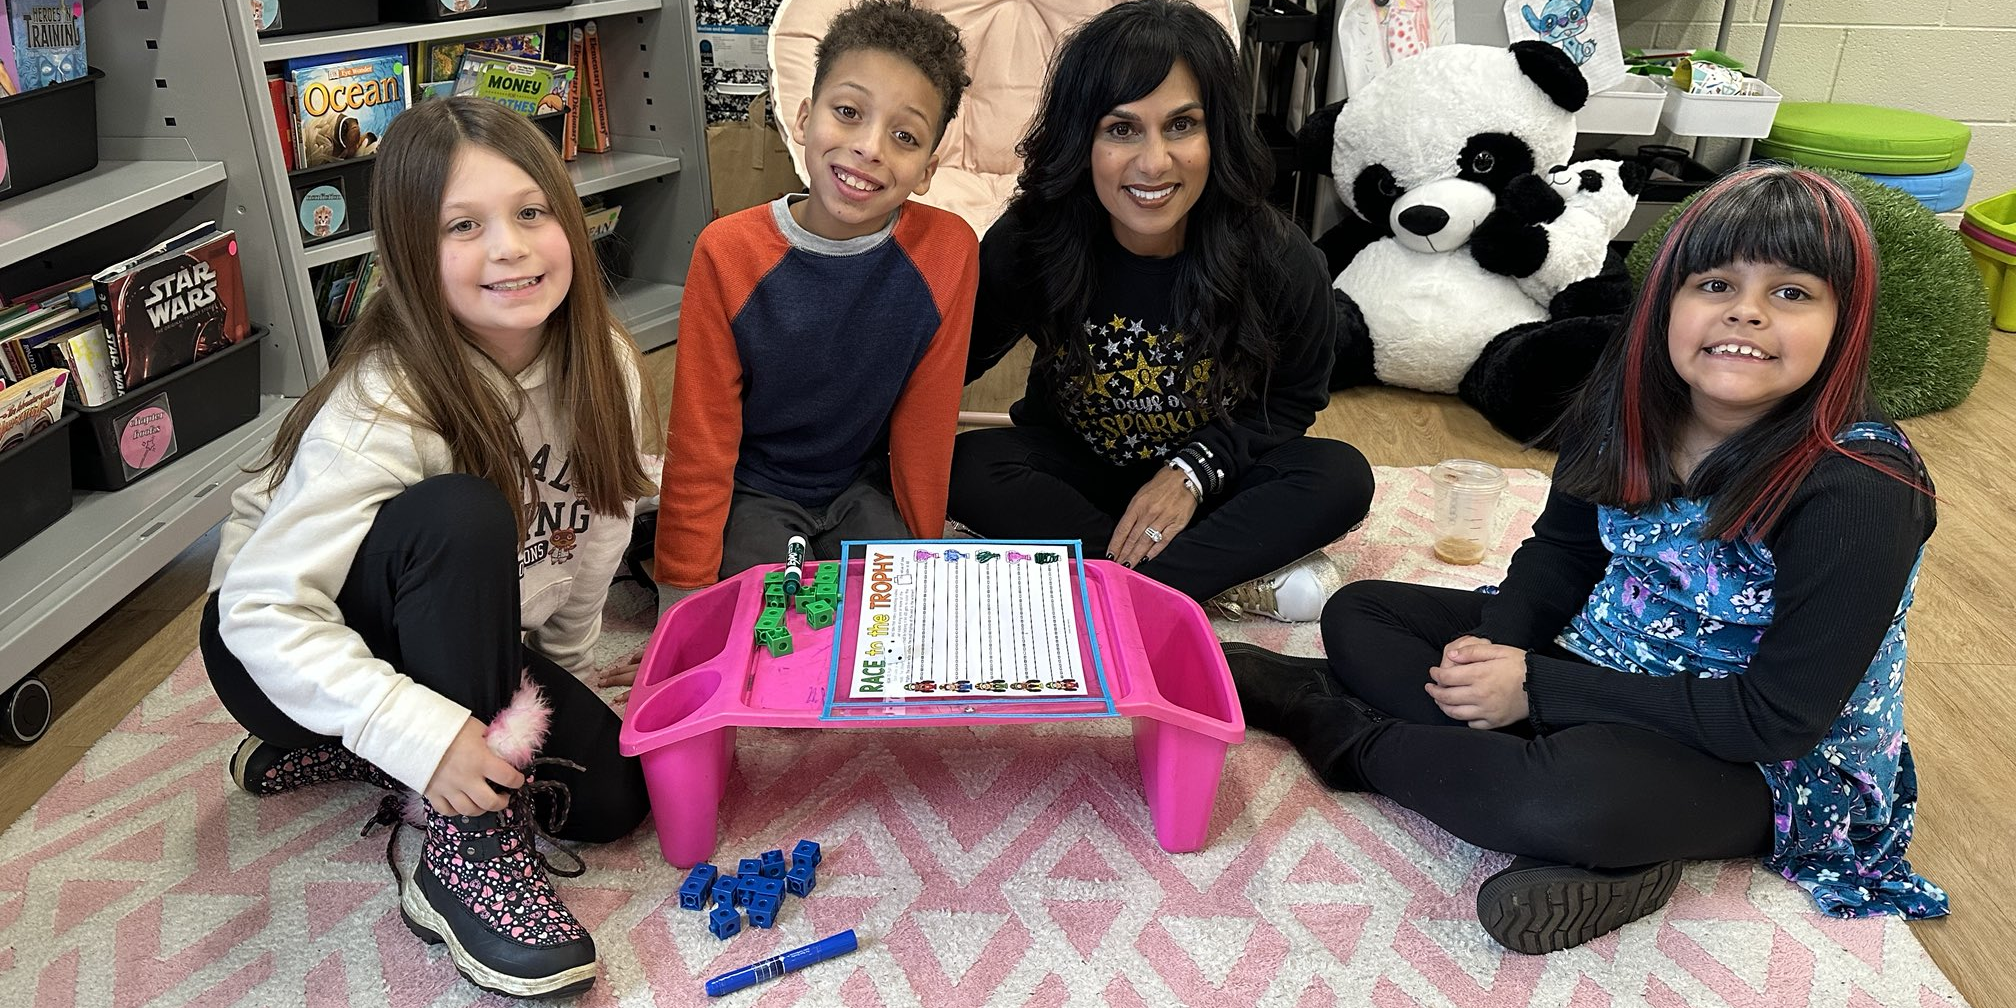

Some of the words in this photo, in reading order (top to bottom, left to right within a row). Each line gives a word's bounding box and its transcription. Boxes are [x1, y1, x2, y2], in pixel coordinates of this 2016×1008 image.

[32, 8, 60, 22] HEROES
[24, 15, 80, 48] TRAINING
[304, 76, 400, 117] Ocean
[488, 75, 542, 94] MONEY
[589, 37, 600, 86] Elementary
[596, 89, 608, 136] Dictionary
[570, 97, 579, 143] Dictionary
[144, 261, 216, 307] STAR
[146, 280, 217, 328] WARS
[105, 328, 120, 368] STAR
[1112, 394, 1163, 412] Days
[130, 412, 164, 427] chapter
[133, 426, 160, 440] books
[788, 552, 800, 566] EXPO
[870, 552, 894, 610] TROPHY
[866, 614, 890, 637] the
[865, 641, 884, 656] to
[859, 660, 886, 692] RACE
